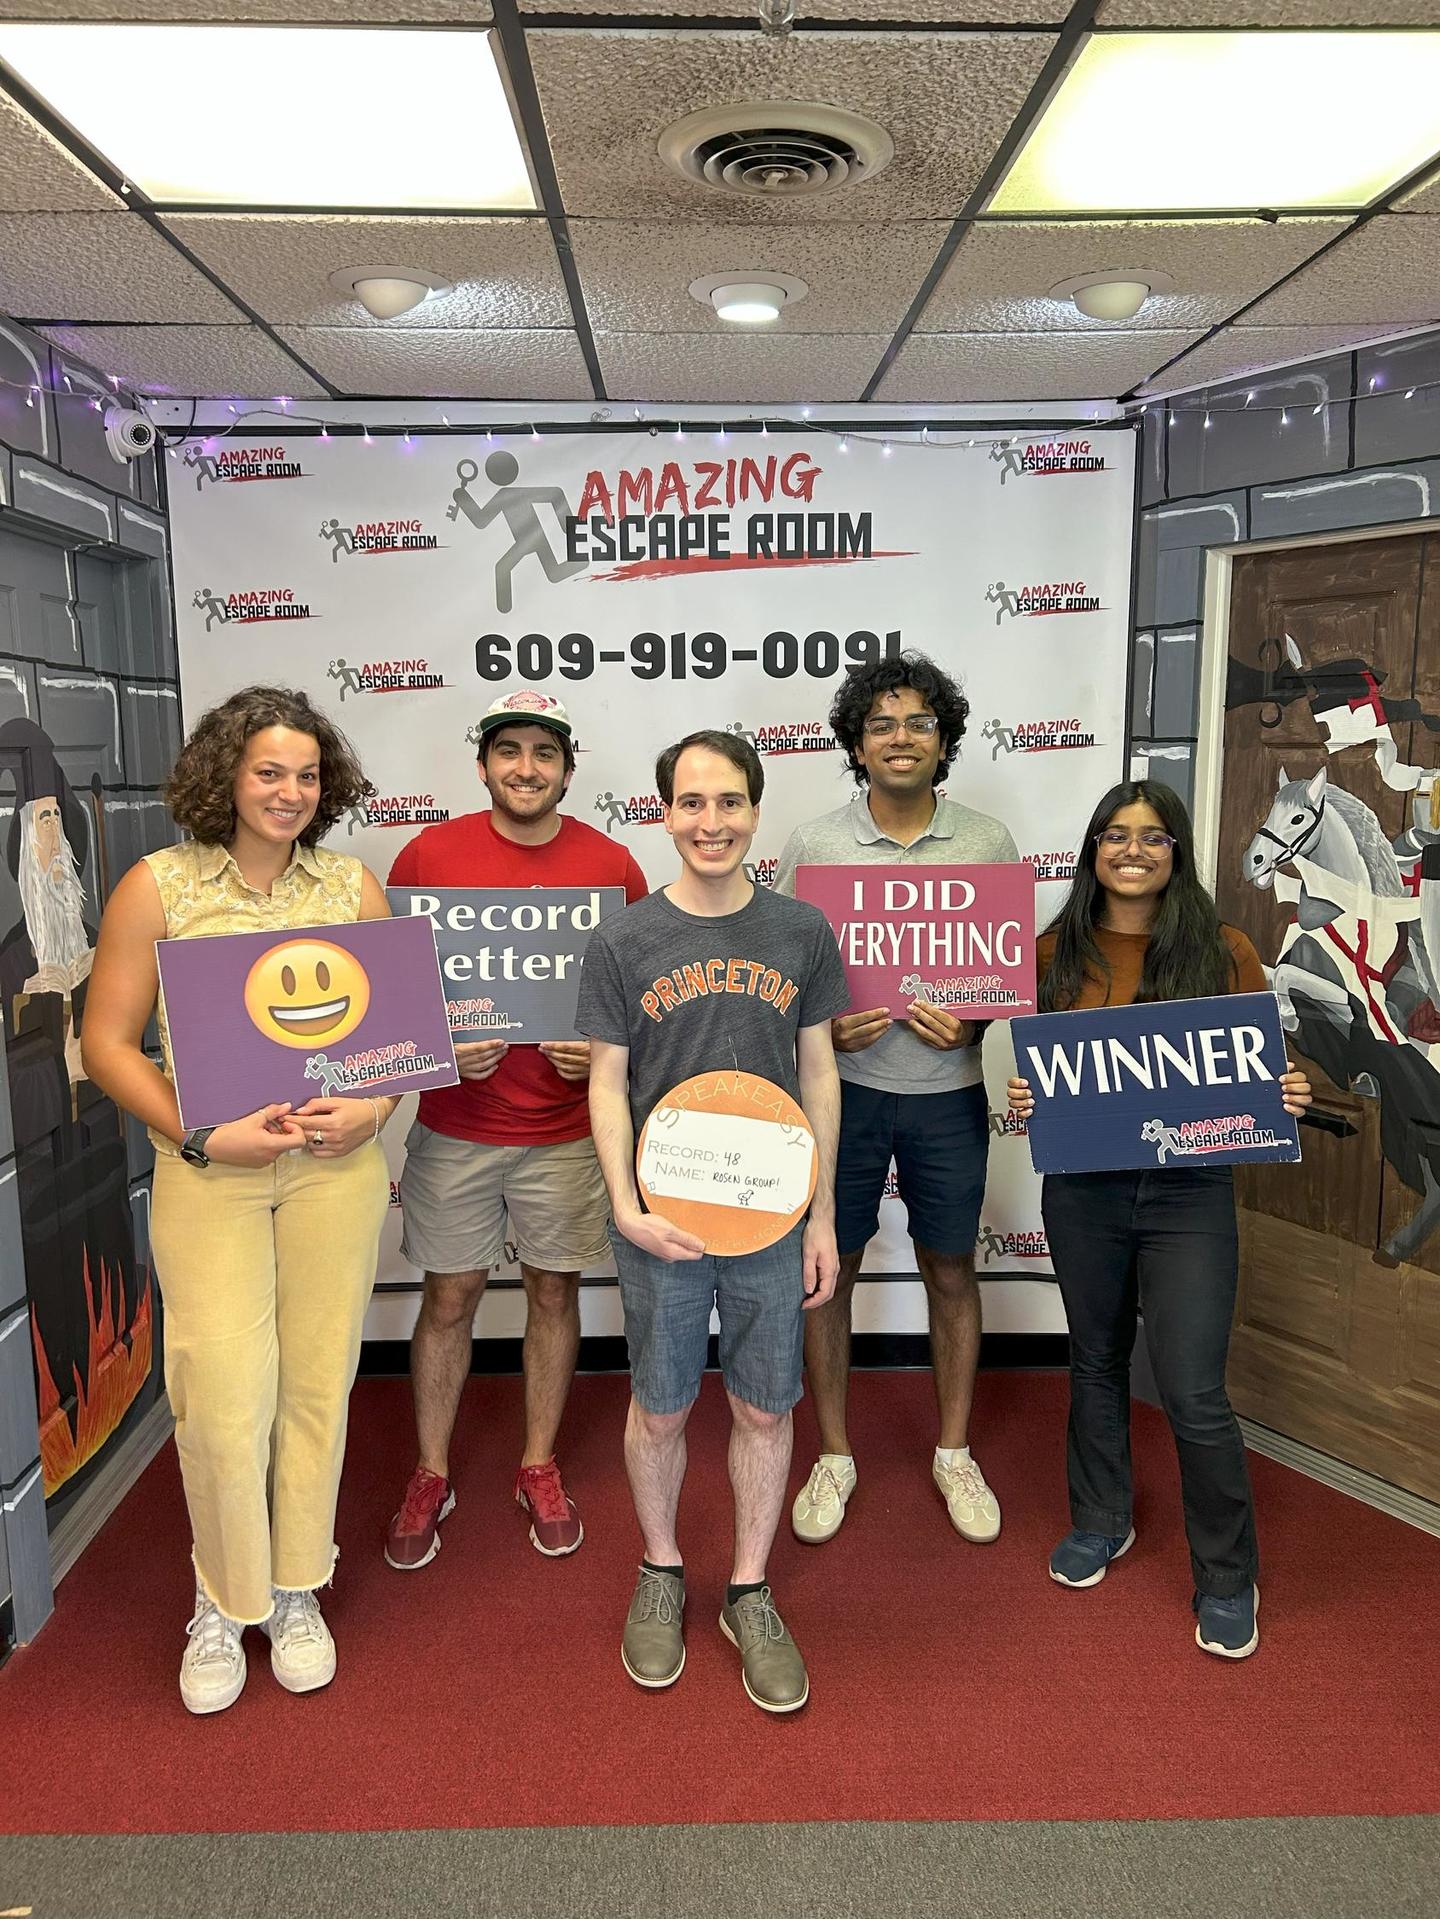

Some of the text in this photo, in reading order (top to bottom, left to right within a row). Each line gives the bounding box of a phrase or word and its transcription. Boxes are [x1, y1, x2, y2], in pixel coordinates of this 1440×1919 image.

[219, 447, 286, 464] AMAZING
[1025, 441, 1091, 458] AMAZING
[216, 463, 300, 477] ESCAPE ROOM
[1022, 457, 1104, 470] ESCAPE ROOM
[578, 453, 822, 524] AMAZING
[355, 520, 422, 536] AMAZING
[352, 536, 437, 549] ESCAPE ROOM
[566, 512, 873, 562] ESCAPE ROOM
[228, 589, 294, 606] AMAZING
[1020, 582, 1086, 599] AMAZING
[225, 605, 309, 618] ESCAPE ROOM
[1017, 598, 1100, 611] ESCAPE ROOM
[362, 659, 428, 676] AMAZING
[359, 675, 443, 688] ESCAPE ROOM
[758, 722, 822, 739] AMAZING
[1016, 719, 1082, 737] AMAZING
[755, 737, 836, 750] ESCAPE ROOM
[1012, 734, 1094, 748] ESCAPE ROOM
[370, 795, 434, 811] AMAZING
[367, 810, 449, 823] ESCAPE ROOM
[1022, 852, 1076, 866] MAZING
[1056, 867, 1077, 878] ROO
[853, 880, 976, 911] I DID
[410, 892, 601, 931] Record
[829, 920, 1022, 967] VERYTHING
[443, 946, 584, 981] etter
[641, 958, 798, 1022] PRINCETON
[935, 975, 1003, 993] AMAZING
[931, 990, 1016, 1003] ESCAPE ROOM
[448, 998, 495, 1014] AZING
[472, 1013, 508, 1026] ROOM
[344, 1041, 418, 1070] AMAZING
[1026, 1025, 1275, 1098] WINNER
[343, 1054, 435, 1084] ESCAPE ROOM
[656, 1078, 807, 1149] SPEAKEASY
[1003, 1119, 1026, 1131] ESC
[1180, 1114, 1255, 1137] AMAZING
[1178, 1129, 1274, 1149] ESCAPE ROOM
[648, 1140, 742, 1166] RECORD: 48
[655, 1161, 781, 1190] NAME: ROSEN GROUP!
[1007, 1231, 1047, 1243] AMAZ
[1003, 1241, 1046, 1253] ESCAPE
